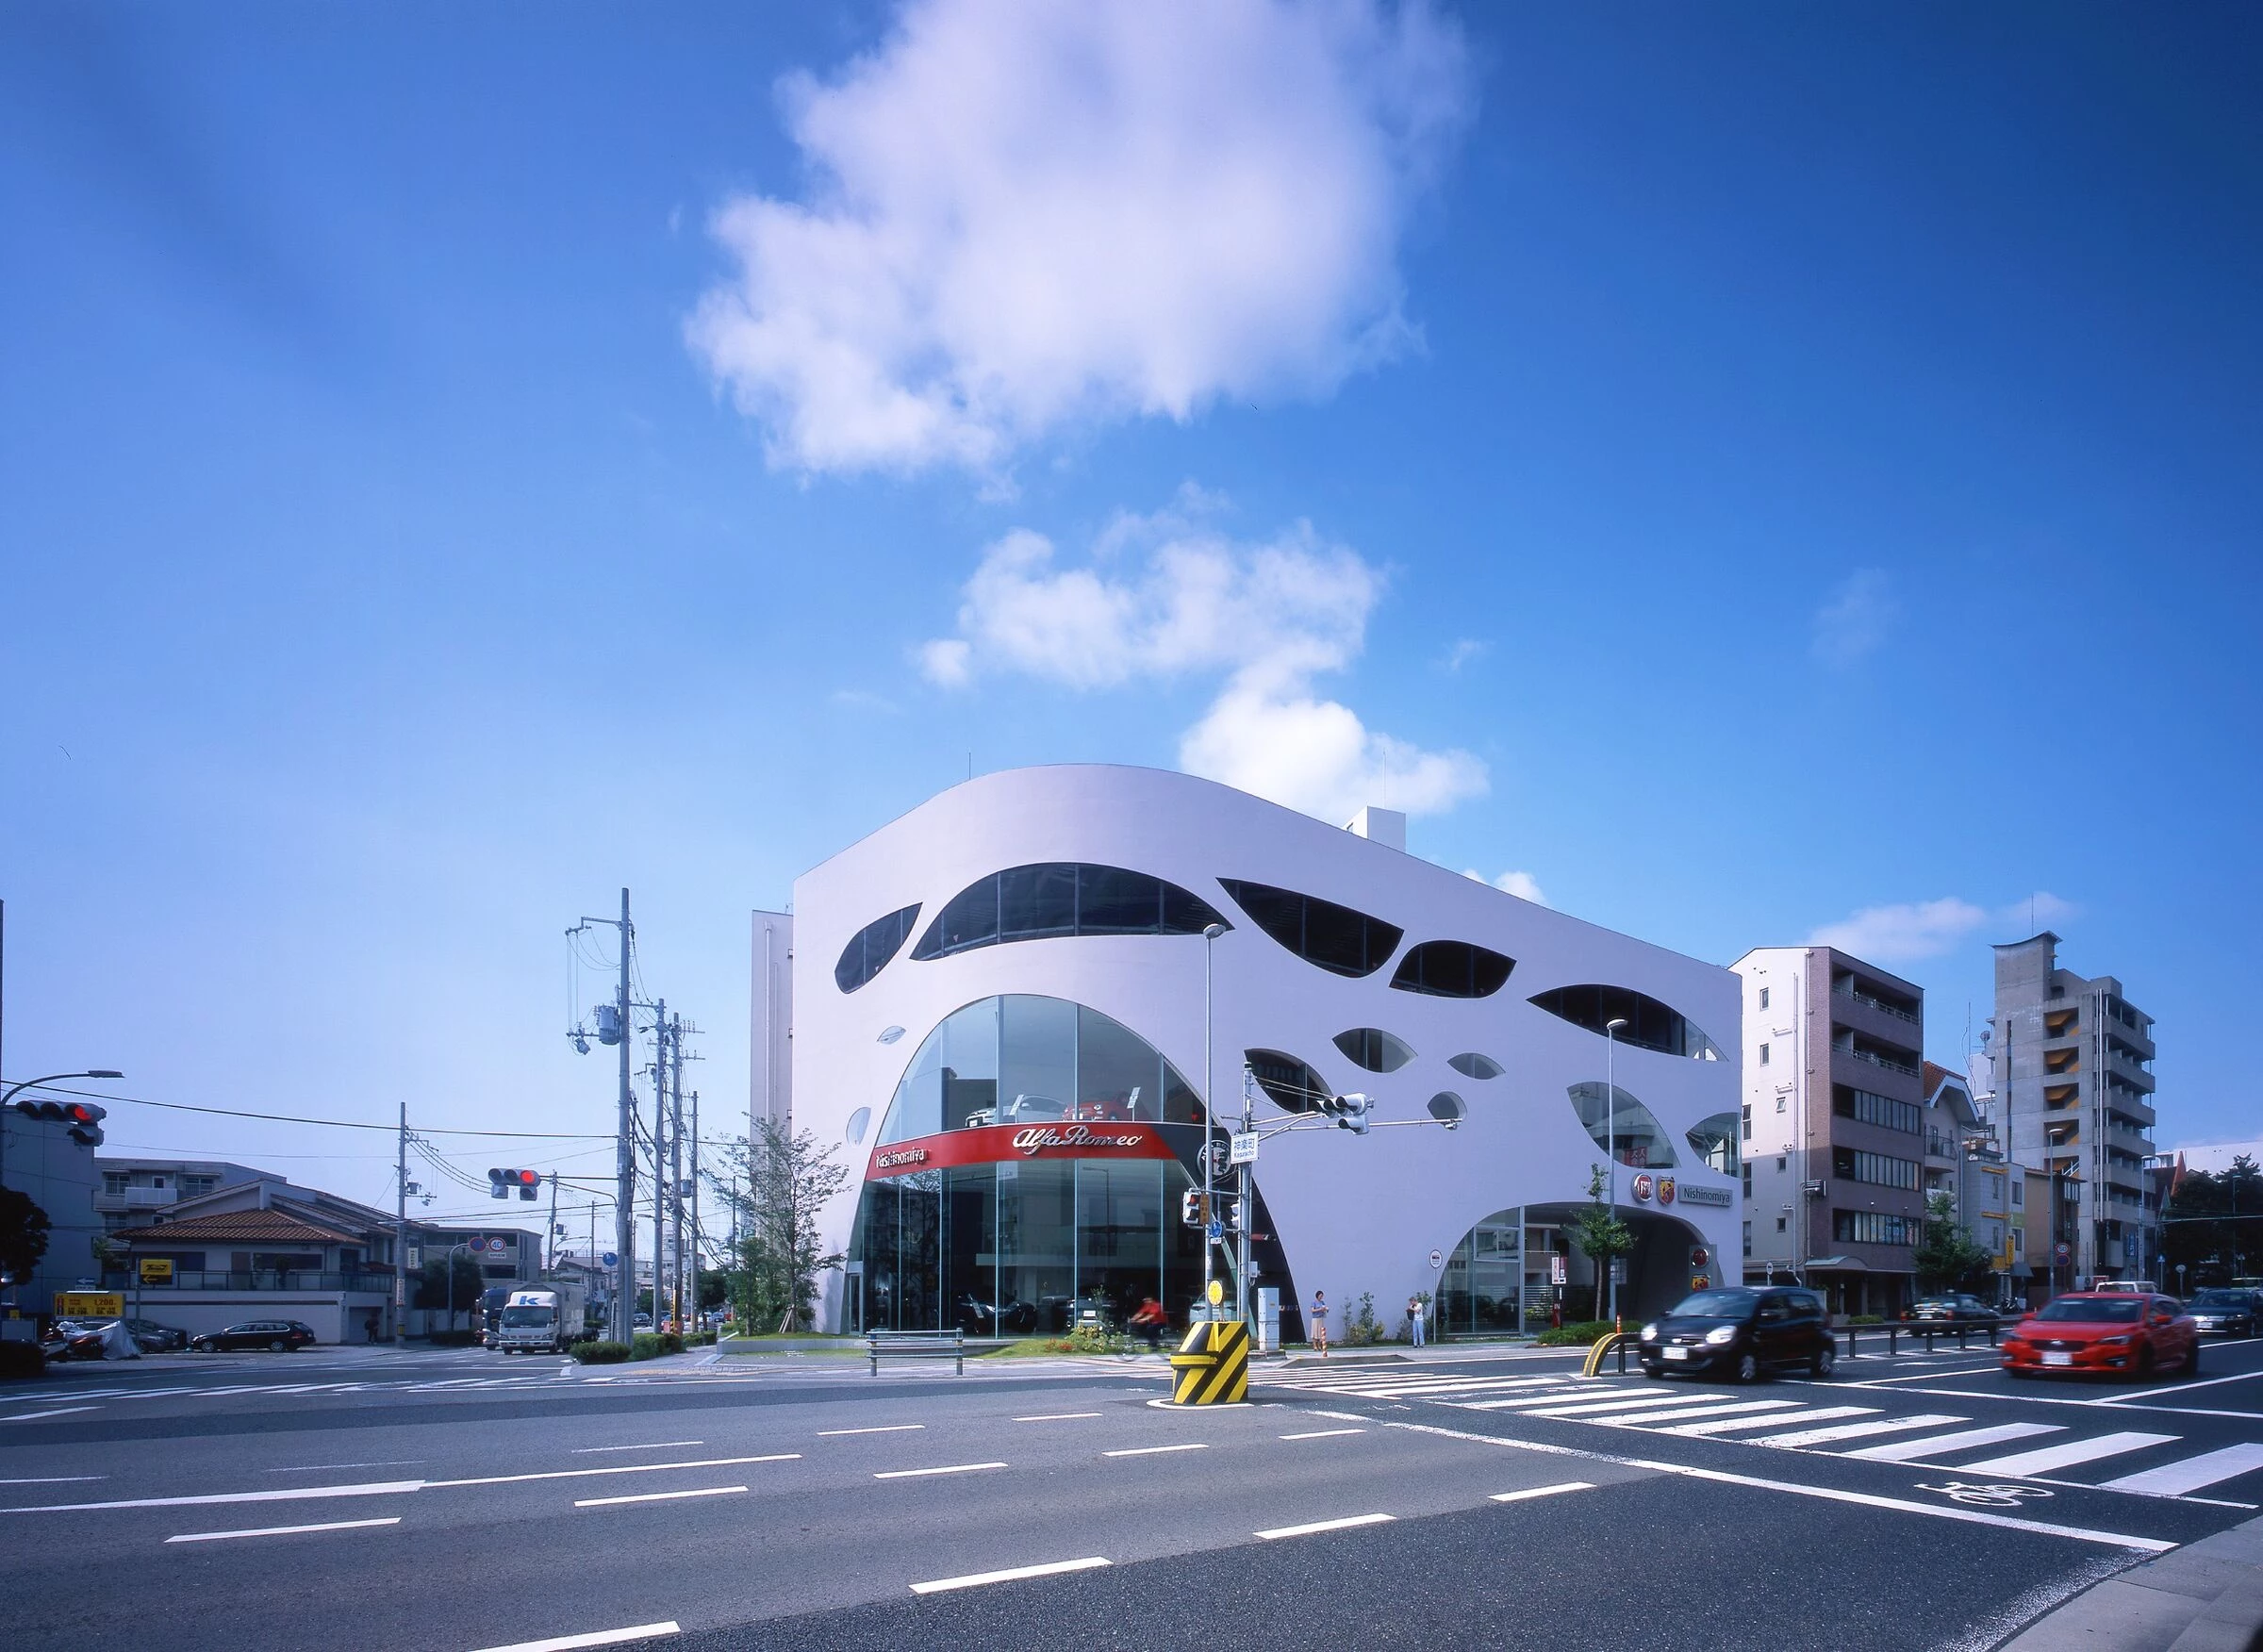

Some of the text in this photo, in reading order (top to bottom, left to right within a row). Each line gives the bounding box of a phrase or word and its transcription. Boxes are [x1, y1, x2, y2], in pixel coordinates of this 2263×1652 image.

[1013, 1125, 1143, 1155] Alfa Romeo
[1234, 1138, 1255, 1150] 神楽町
[1684, 1188, 1730, 1204] Nishinomiya
[491, 1240, 503, 1248] 40
